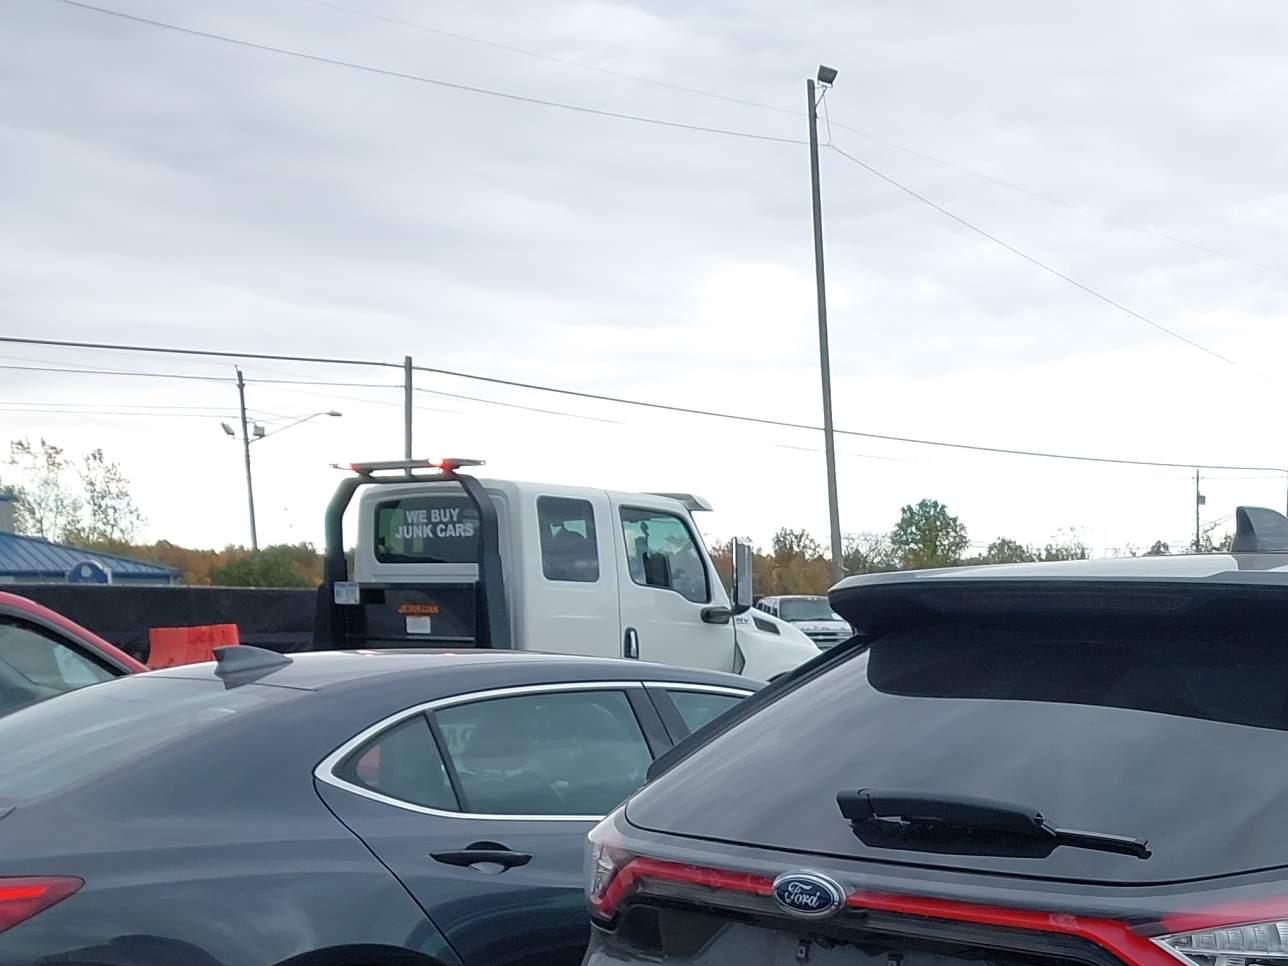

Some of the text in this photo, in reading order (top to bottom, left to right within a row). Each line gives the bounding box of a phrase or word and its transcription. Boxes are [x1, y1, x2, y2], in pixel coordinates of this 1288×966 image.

[406, 508, 460, 523] WE BUY
[395, 523, 474, 538] JUNK CARS
[784, 881, 821, 908] Ford
